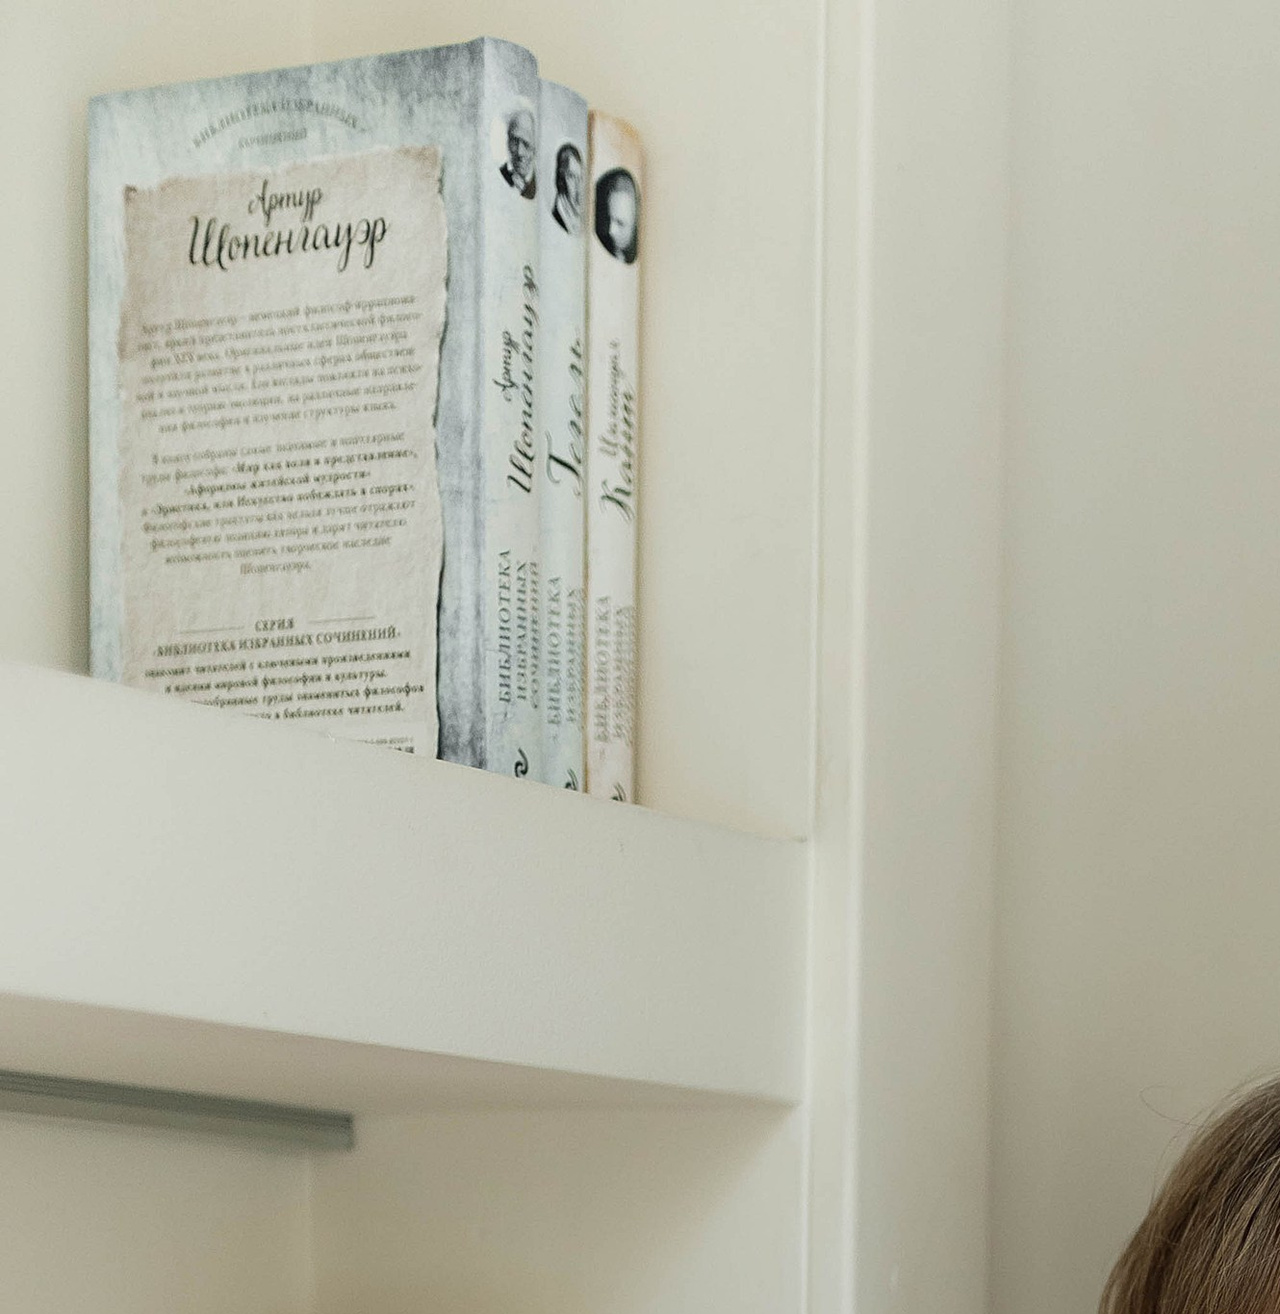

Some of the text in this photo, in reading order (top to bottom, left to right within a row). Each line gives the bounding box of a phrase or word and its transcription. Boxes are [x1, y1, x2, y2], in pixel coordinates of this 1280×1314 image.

[248, 178, 323, 227] Артур
[188, 214, 391, 273] Шопенгауэр
[499, 549, 512, 703] БИБЛИОТЕКА
